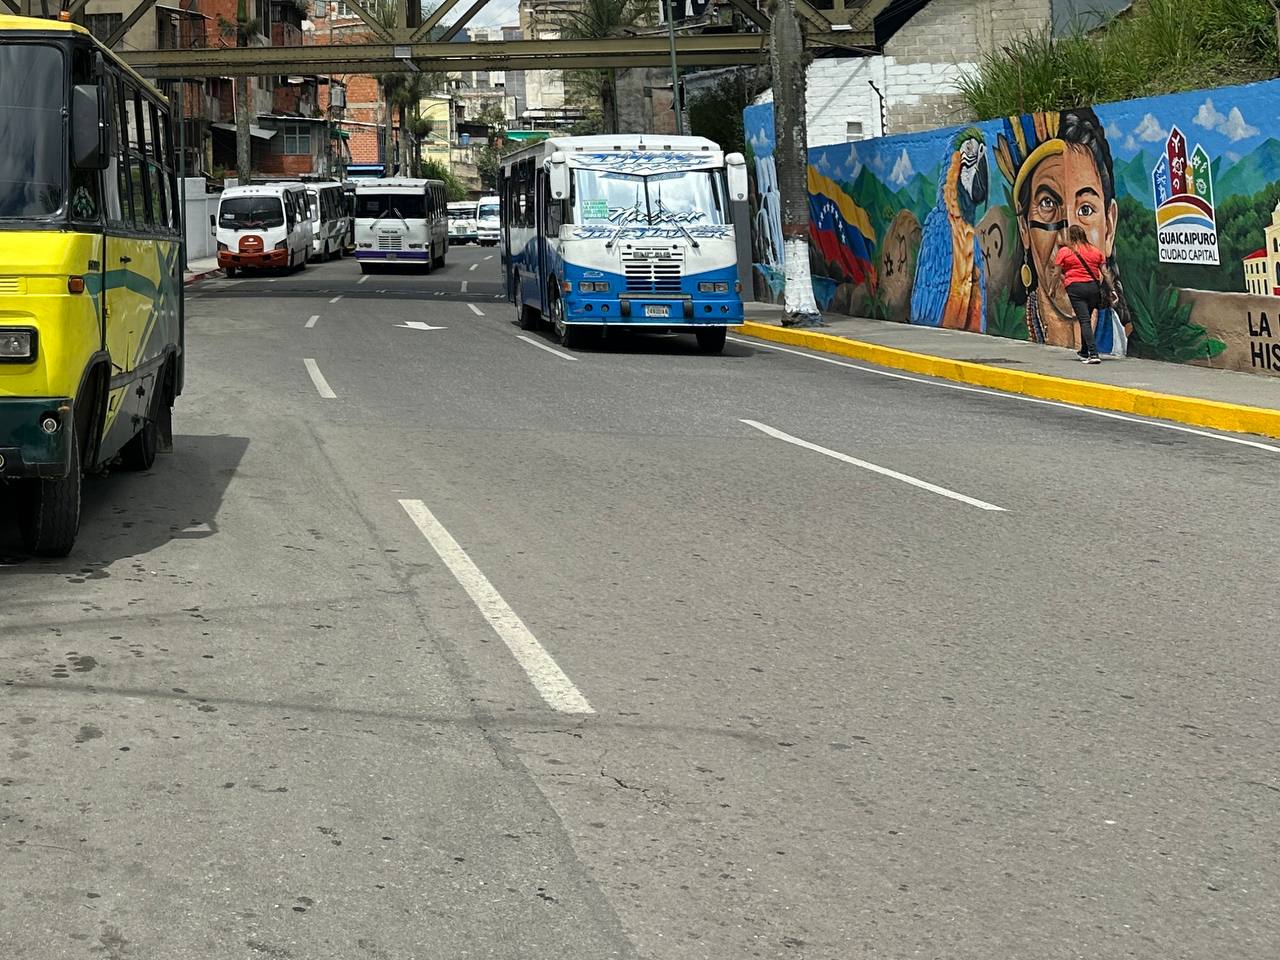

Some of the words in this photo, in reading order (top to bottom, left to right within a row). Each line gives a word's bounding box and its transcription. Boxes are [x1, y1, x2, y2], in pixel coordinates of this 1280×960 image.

[1159, 231, 1217, 246] GUAICAIPURO
[1160, 248, 1188, 261] CIUDAD
[1188, 249, 1219, 262] CAPITAL
[1247, 311, 1272, 338] LA
